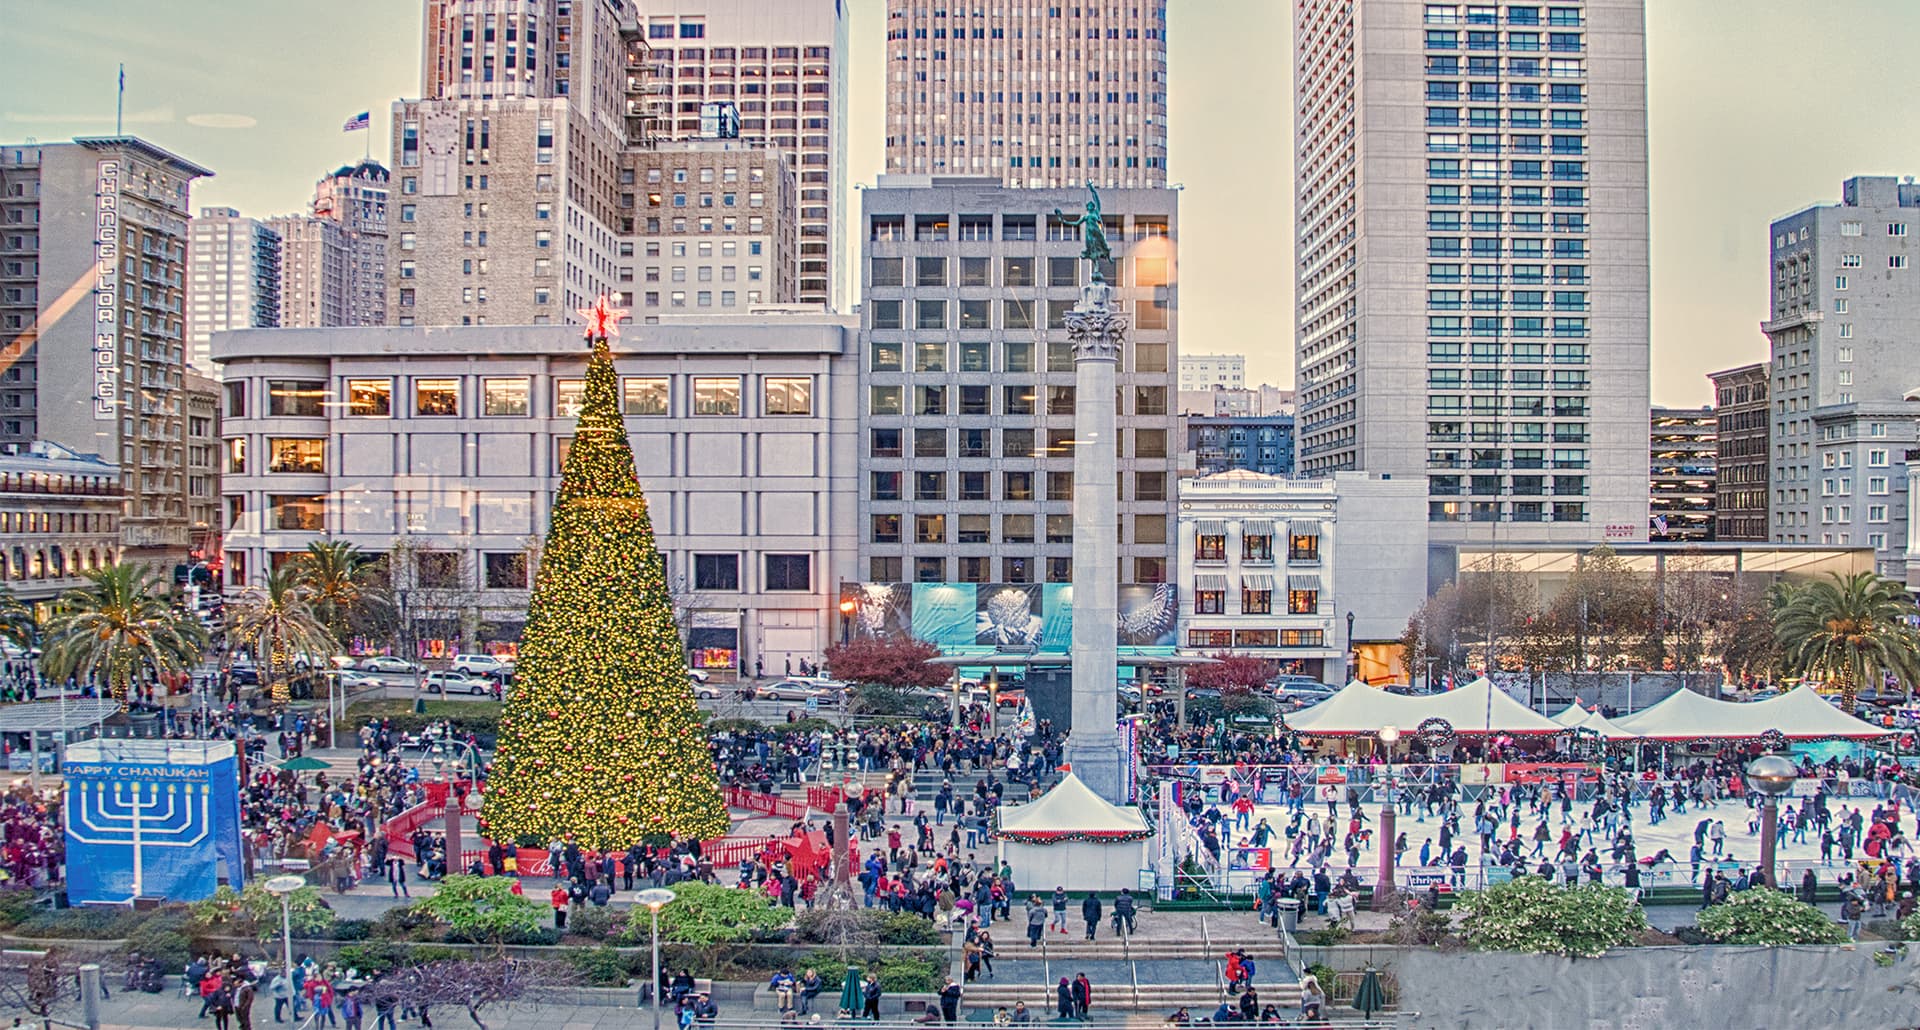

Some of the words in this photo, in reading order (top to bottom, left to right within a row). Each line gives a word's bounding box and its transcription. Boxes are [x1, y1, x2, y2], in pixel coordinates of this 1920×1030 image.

[98, 161, 119, 324] CHANCELLOR
[96, 332, 115, 415] HOTEL
[63, 765, 113, 775] HAPPY
[117, 766, 209, 777] CHANUKAH
